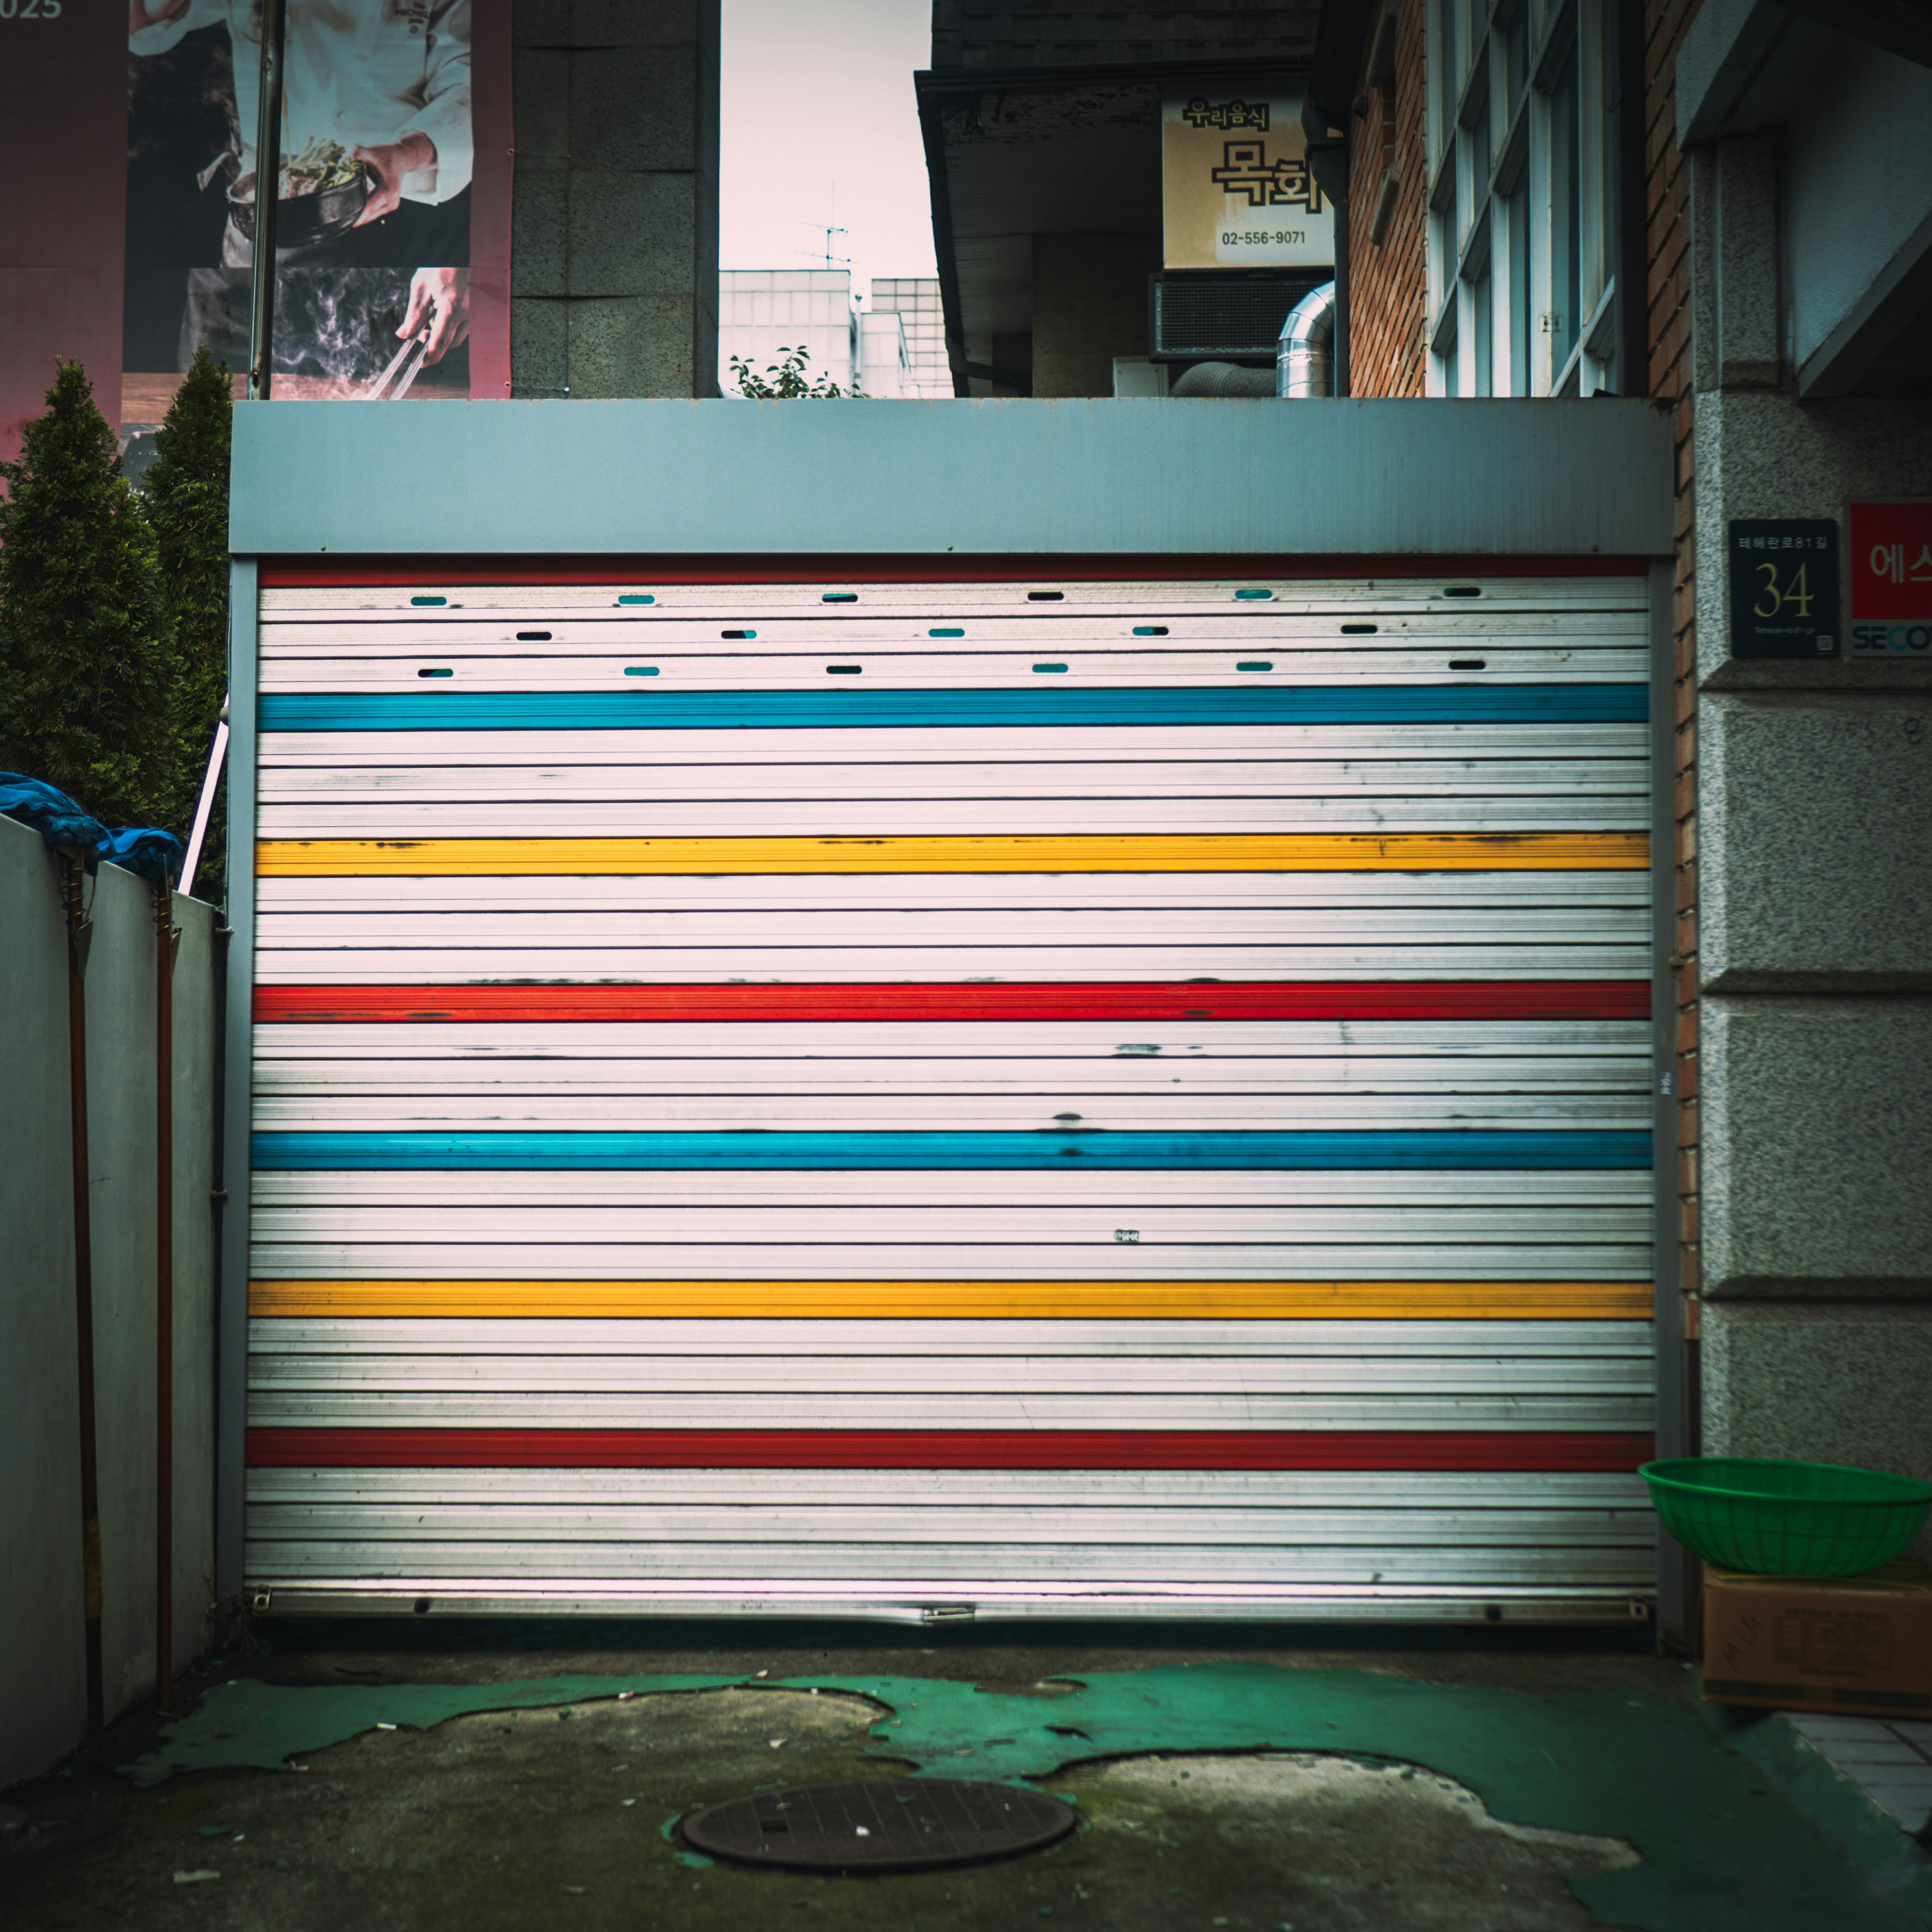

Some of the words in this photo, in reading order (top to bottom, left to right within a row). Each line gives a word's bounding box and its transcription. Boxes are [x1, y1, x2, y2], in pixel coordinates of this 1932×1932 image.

[1185, 99, 1267, 130] 우리음식
[1222, 231, 1305, 245] 02-556-9071
[1754, 561, 1814, 617] 34
[1853, 625, 1932, 651] SECO
